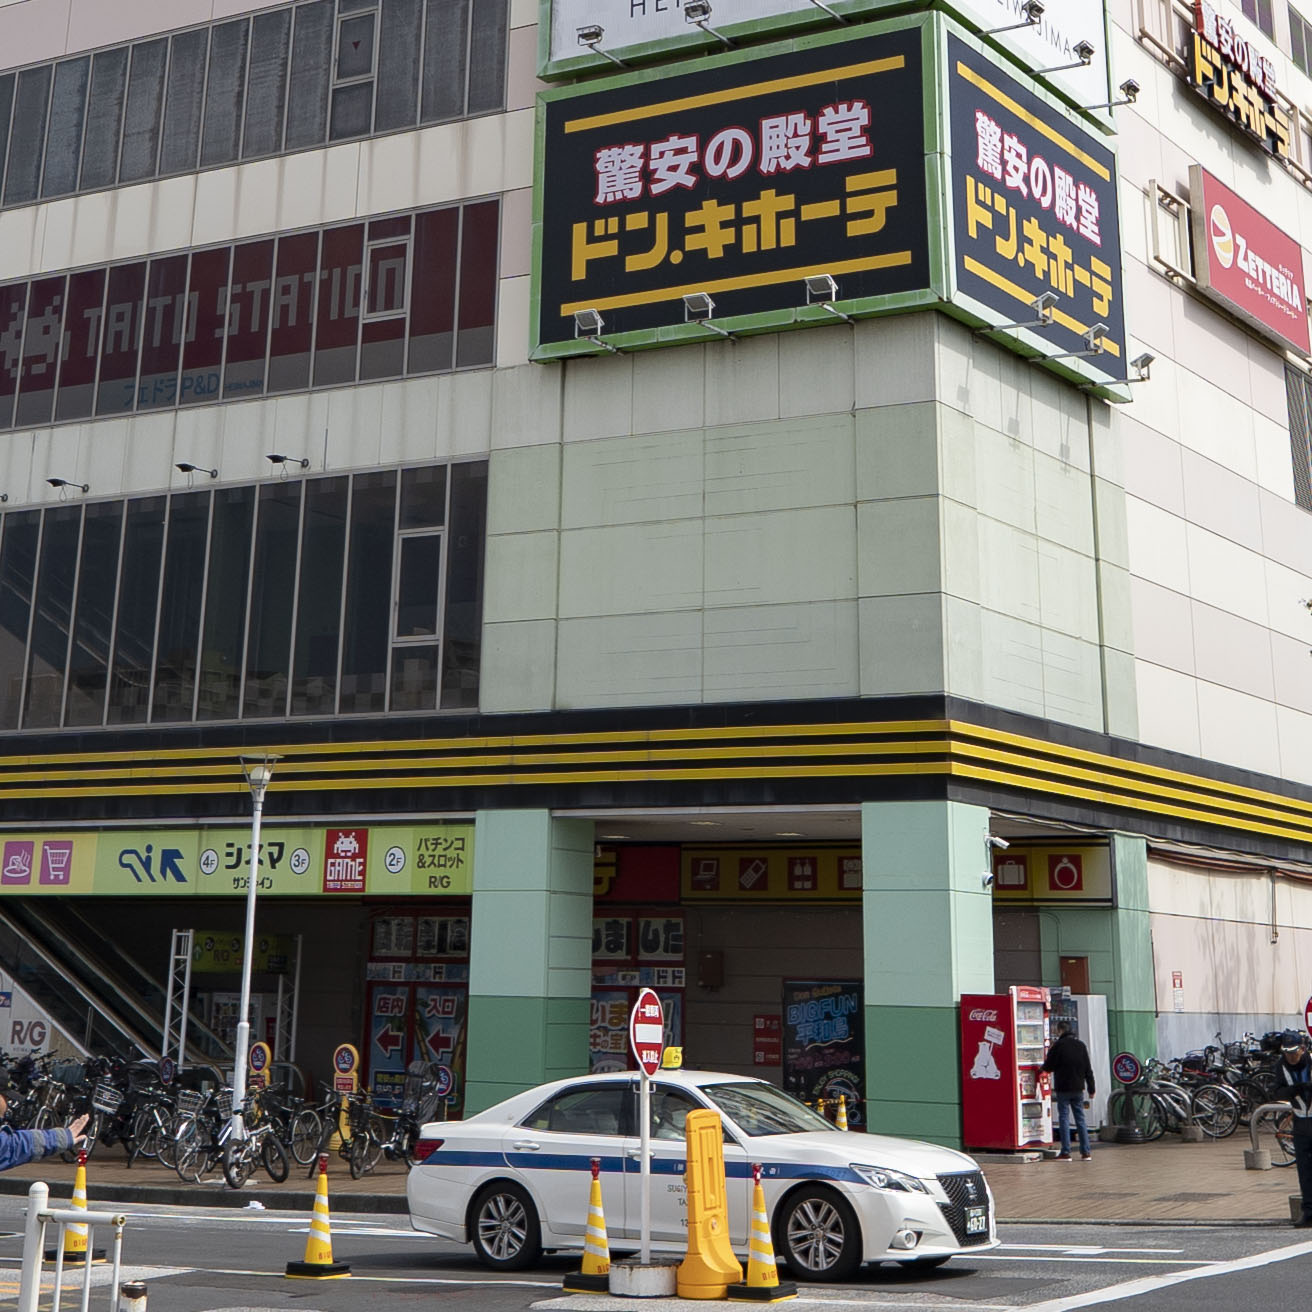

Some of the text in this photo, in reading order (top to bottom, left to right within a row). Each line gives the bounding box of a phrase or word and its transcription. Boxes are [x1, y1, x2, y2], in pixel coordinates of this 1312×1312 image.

[593, 99, 873, 205] 驚安の殿堂
[974, 109, 1102, 247] 驚安の殿堂
[1235, 233, 1302, 312] ZETTERIA
[84, 256, 406, 358] TAITO STATION
[417, 837, 465, 852] パチンコ
[203, 856, 215, 868] 4F
[294, 854, 306, 867] 3F
[326, 858, 365, 880] GAME
[388, 852, 402, 865] 2F
[426, 996, 457, 1017] 入口
